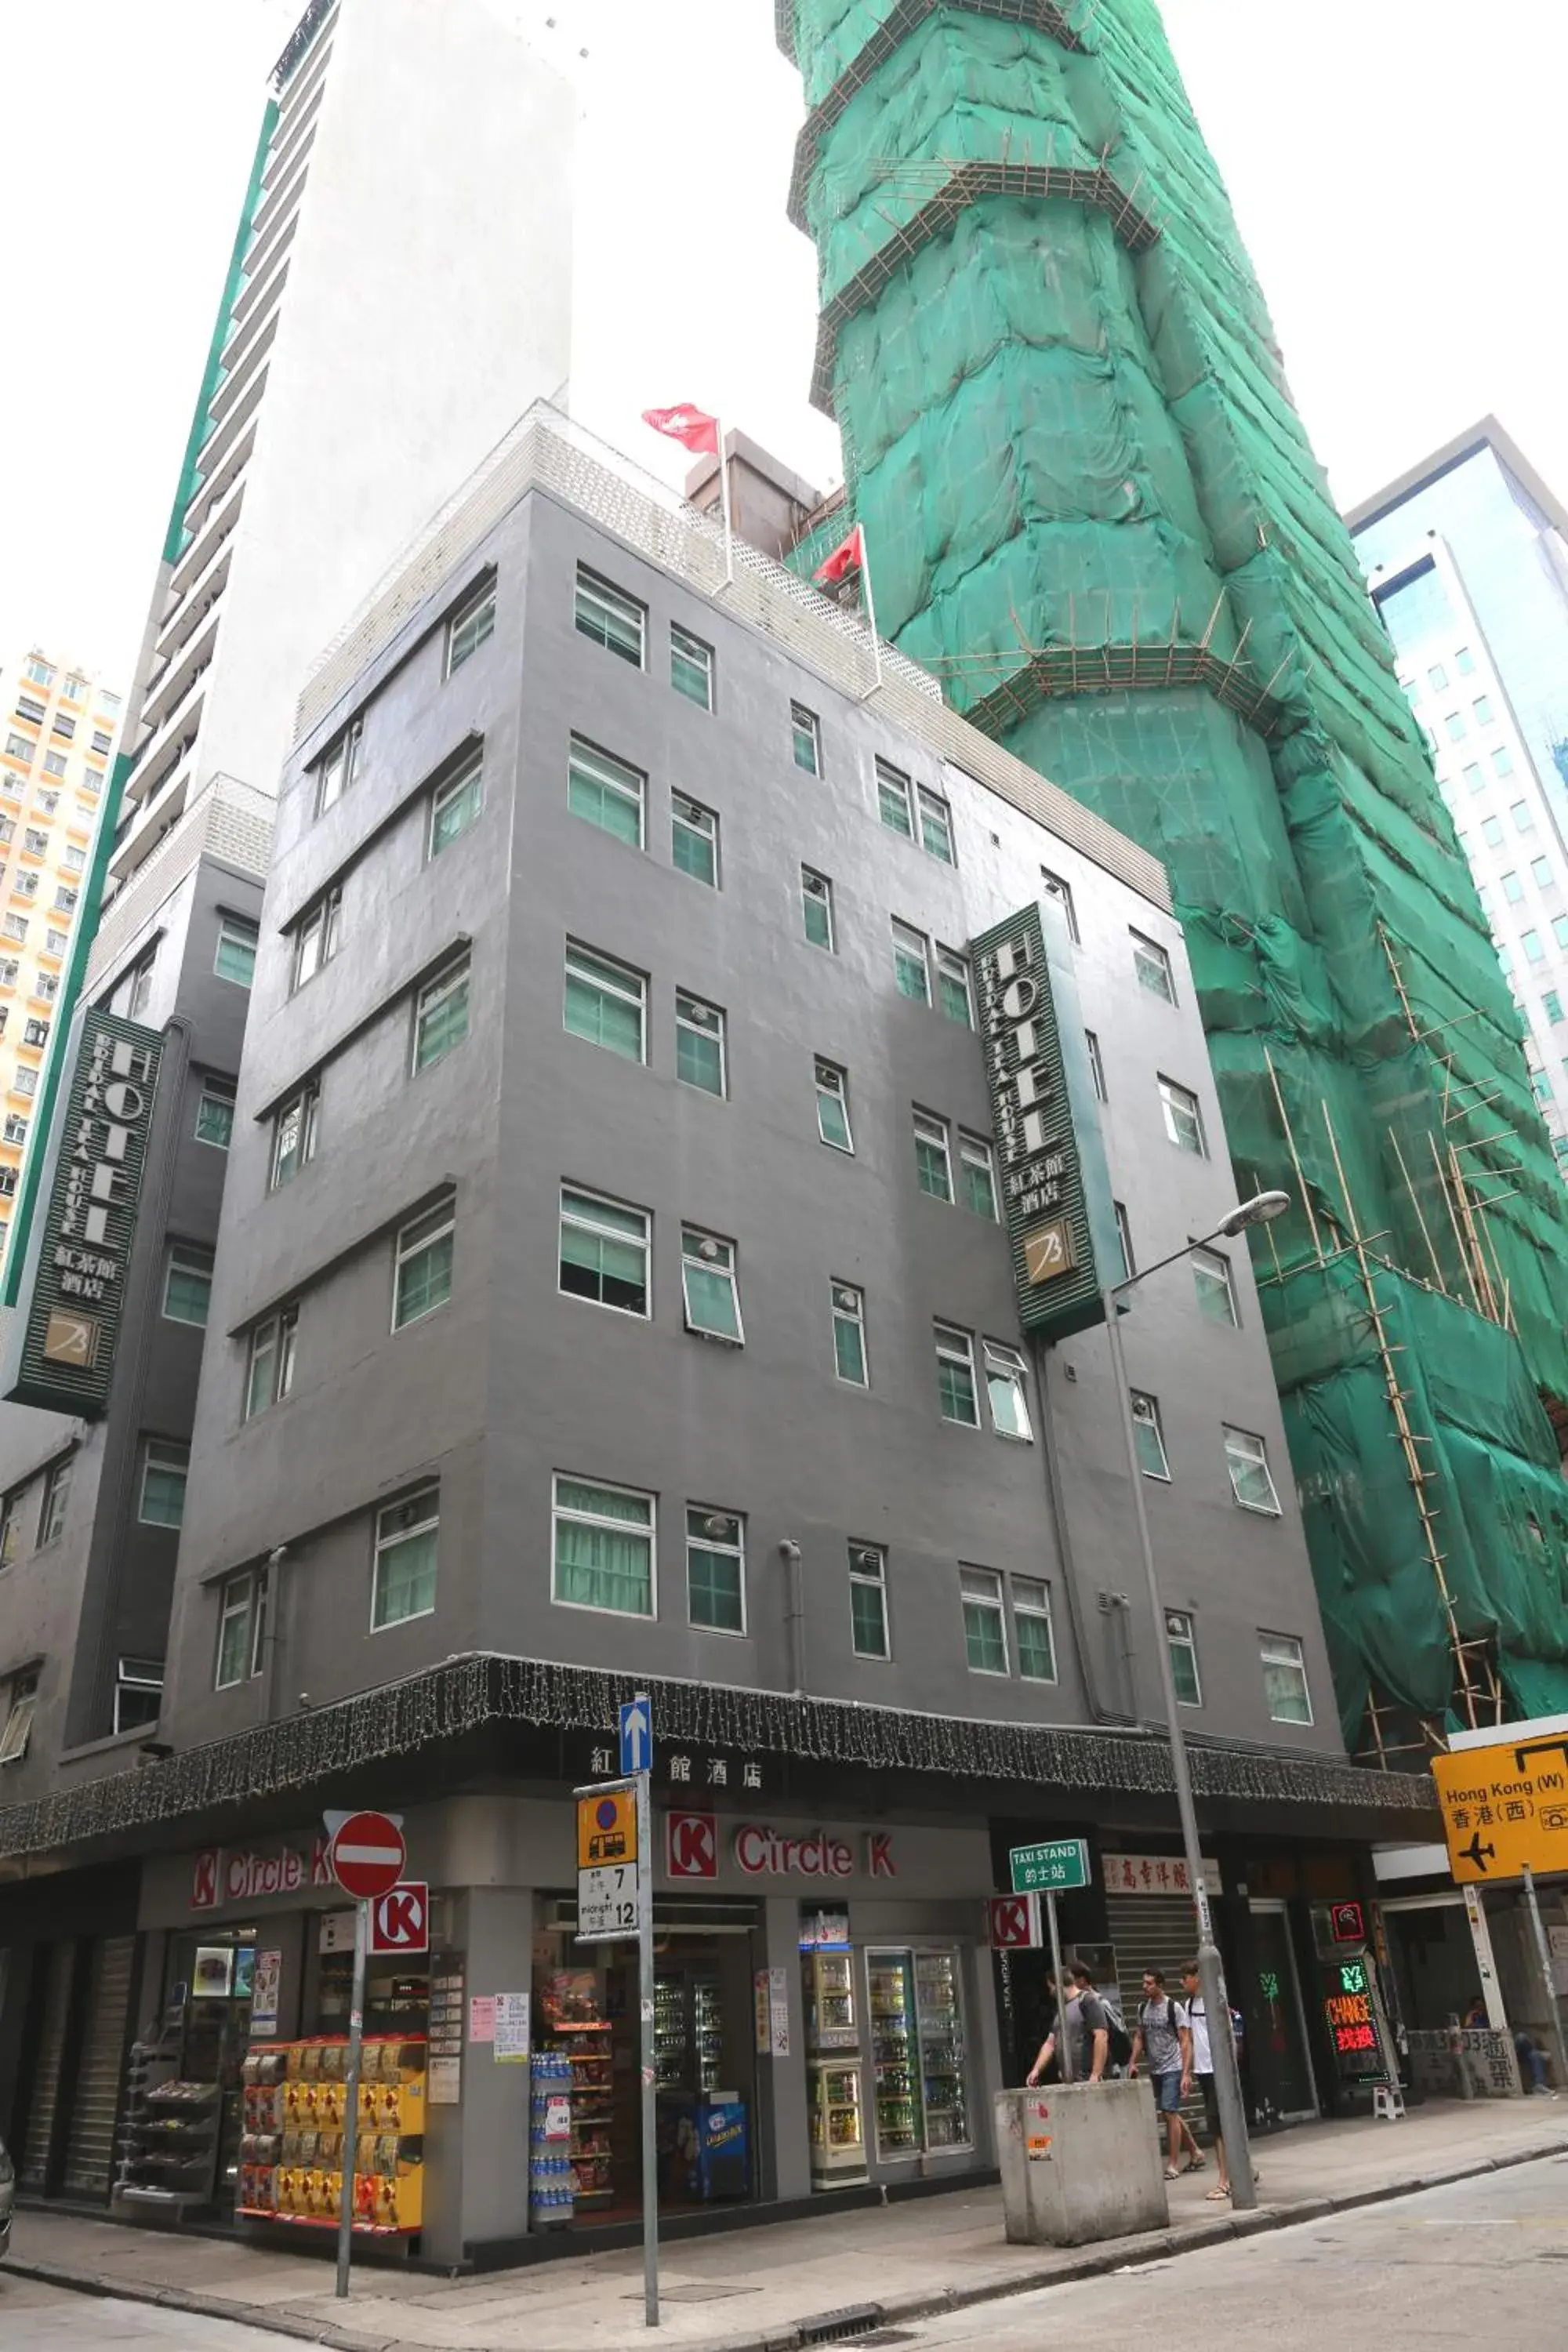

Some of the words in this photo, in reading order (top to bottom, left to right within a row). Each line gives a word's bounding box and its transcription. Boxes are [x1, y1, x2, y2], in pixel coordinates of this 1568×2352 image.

[992, 1040, 1012, 1087] TEA
[996, 931, 1066, 1154] HOTEL
[73, 1116, 95, 1161] TEA
[85, 1040, 151, 1248] HOTEL
[998, 1091, 1018, 1162] HOUSE
[61, 1165, 87, 1236] HOUSE
[1021, 1180, 1060, 1214] 酒店
[591, 1746, 763, 1788] 紅館酒店
[1446, 1788, 1487, 1803] Hong
[1491, 1780, 1533, 1796] Kong
[1537, 1772, 1564, 1793] (W)
[1452, 1800, 1534, 1829] 香港(西)
[226, 1846, 303, 1899] Circle
[736, 1824, 853, 1878] Circle
[869, 1834, 897, 1878] K
[1014, 1853, 1035, 1865] TAXI
[1036, 1845, 1077, 1860] STAND
[614, 1869, 625, 1889] 7
[1025, 1863, 1066, 1884] 的士站
[384, 1893, 423, 1944] K
[615, 1902, 633, 1925] 12
[998, 1900, 1025, 1943] K
